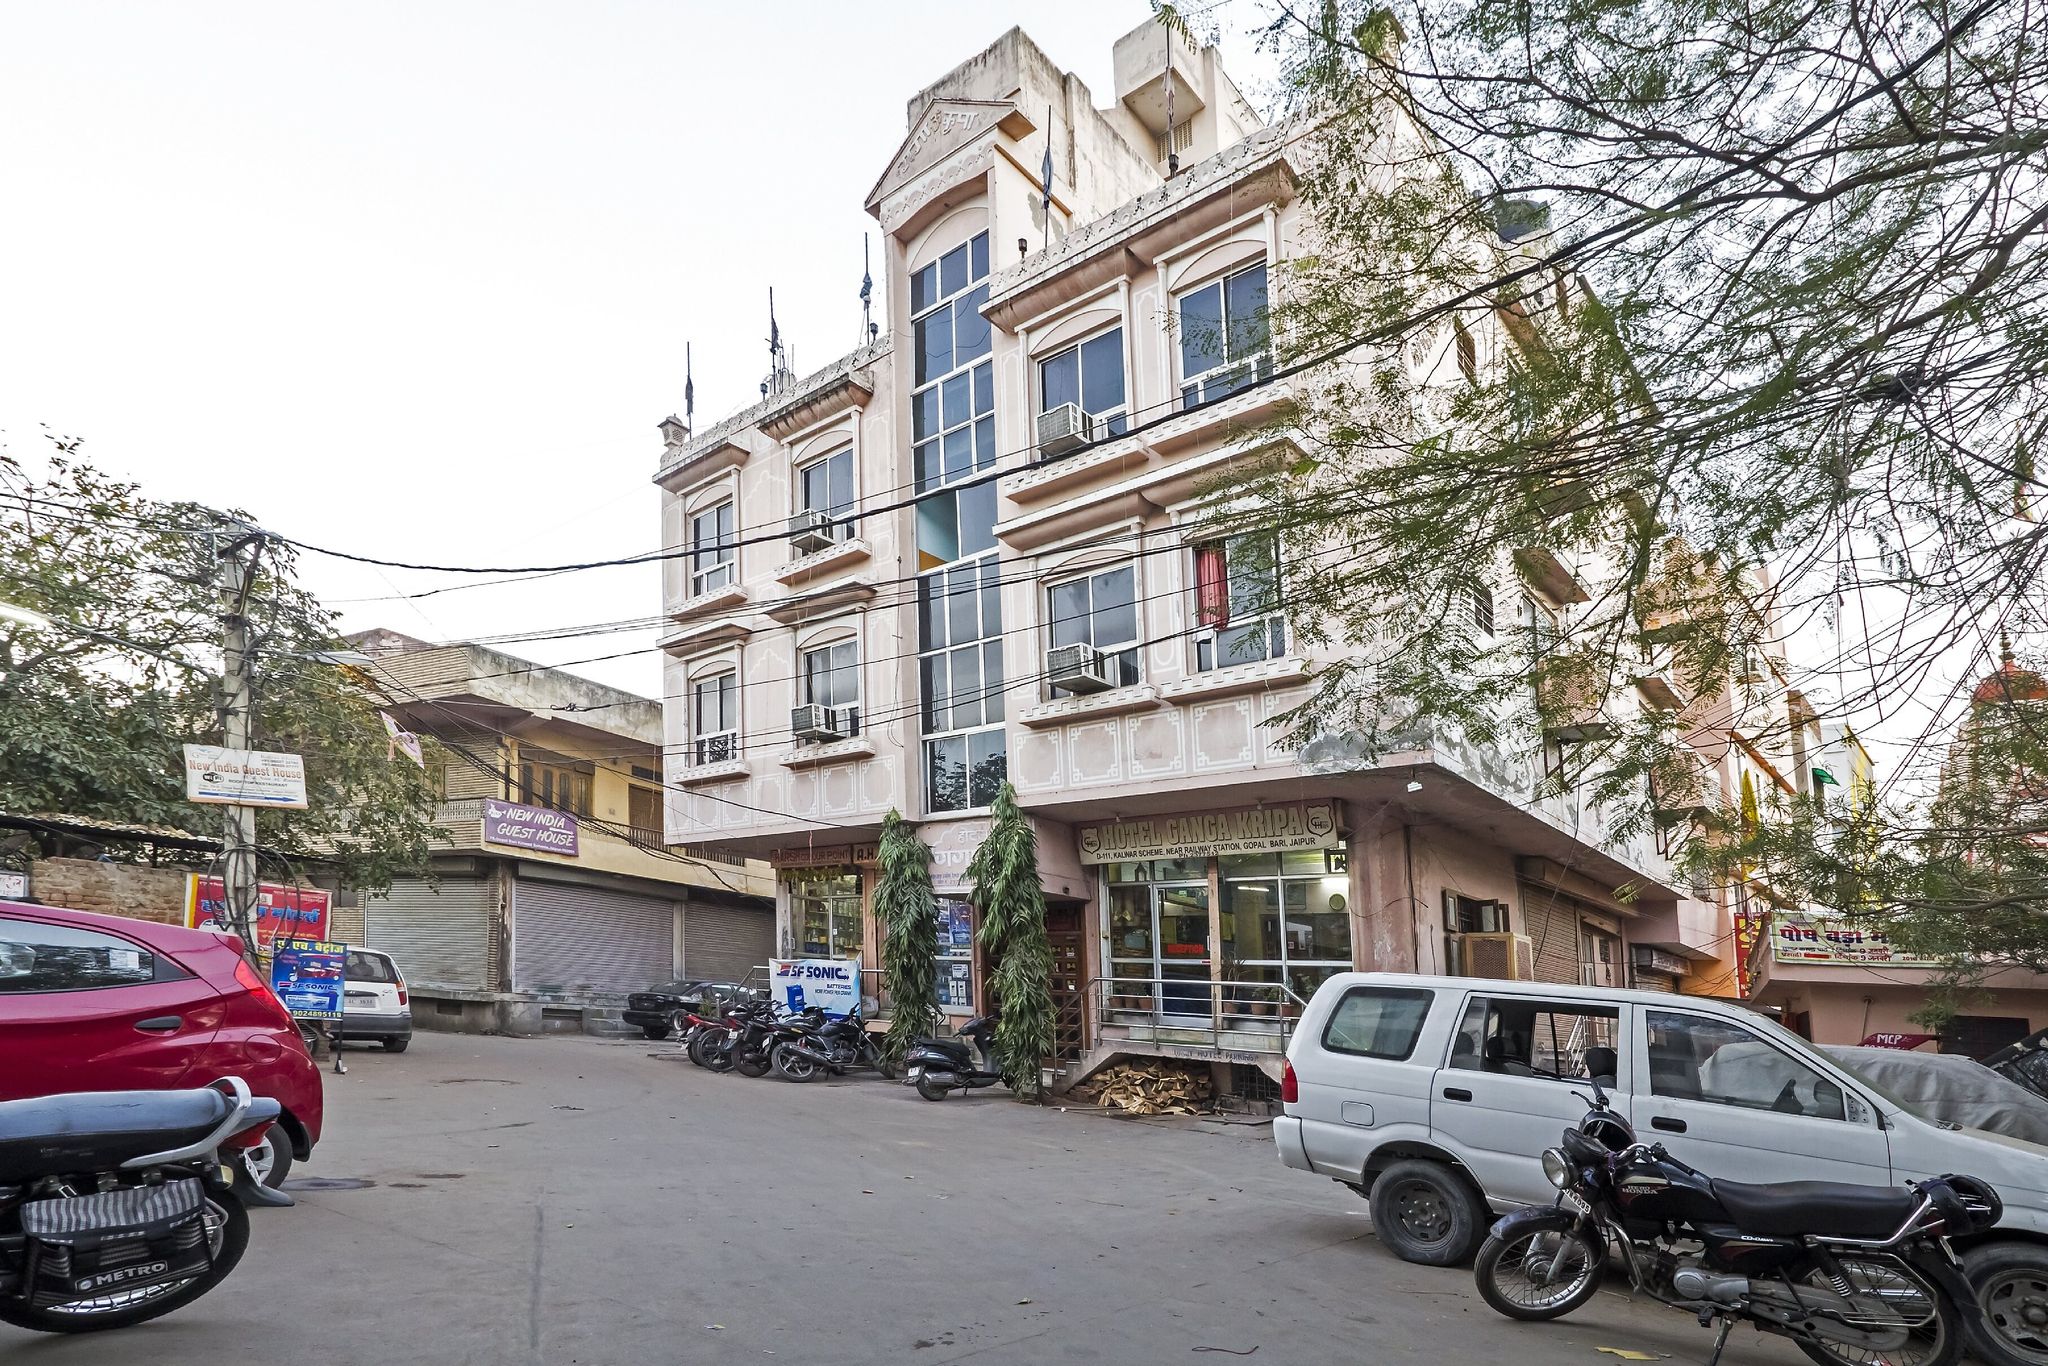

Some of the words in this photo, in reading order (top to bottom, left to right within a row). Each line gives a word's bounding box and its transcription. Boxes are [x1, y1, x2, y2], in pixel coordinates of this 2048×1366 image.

[189, 760, 209, 771] New
[213, 763, 239, 774] India
[241, 765, 270, 776] Guest
[273, 767, 302, 779] House
[506, 808, 534, 822] NEW
[534, 812, 566, 829] INDIA
[1102, 820, 1163, 850] HOTEL
[1235, 807, 1305, 840] KRIPA
[497, 822, 536, 840] GUEST
[536, 829, 575, 847] HOUSE
[1096, 851, 1113, 860] D-111,
[1113, 848, 1138, 859] KALWAR
[1166, 847, 1183, 855] NEAR
[1184, 844, 1212, 854] RAILWAY
[1243, 840, 1267, 850] GOPAL
[1270, 839, 1288, 848] BARI,
[1289, 837, 1316, 847] JAIPUR
[790, 965, 804, 977] SF
[806, 966, 849, 980] SONIC
[304, 983, 336, 991] SONIC
[1876, 1033, 1903, 1045] MCP
[1622, 1187, 1658, 1195] HONDA
[96, 1262, 166, 1285] METRO
